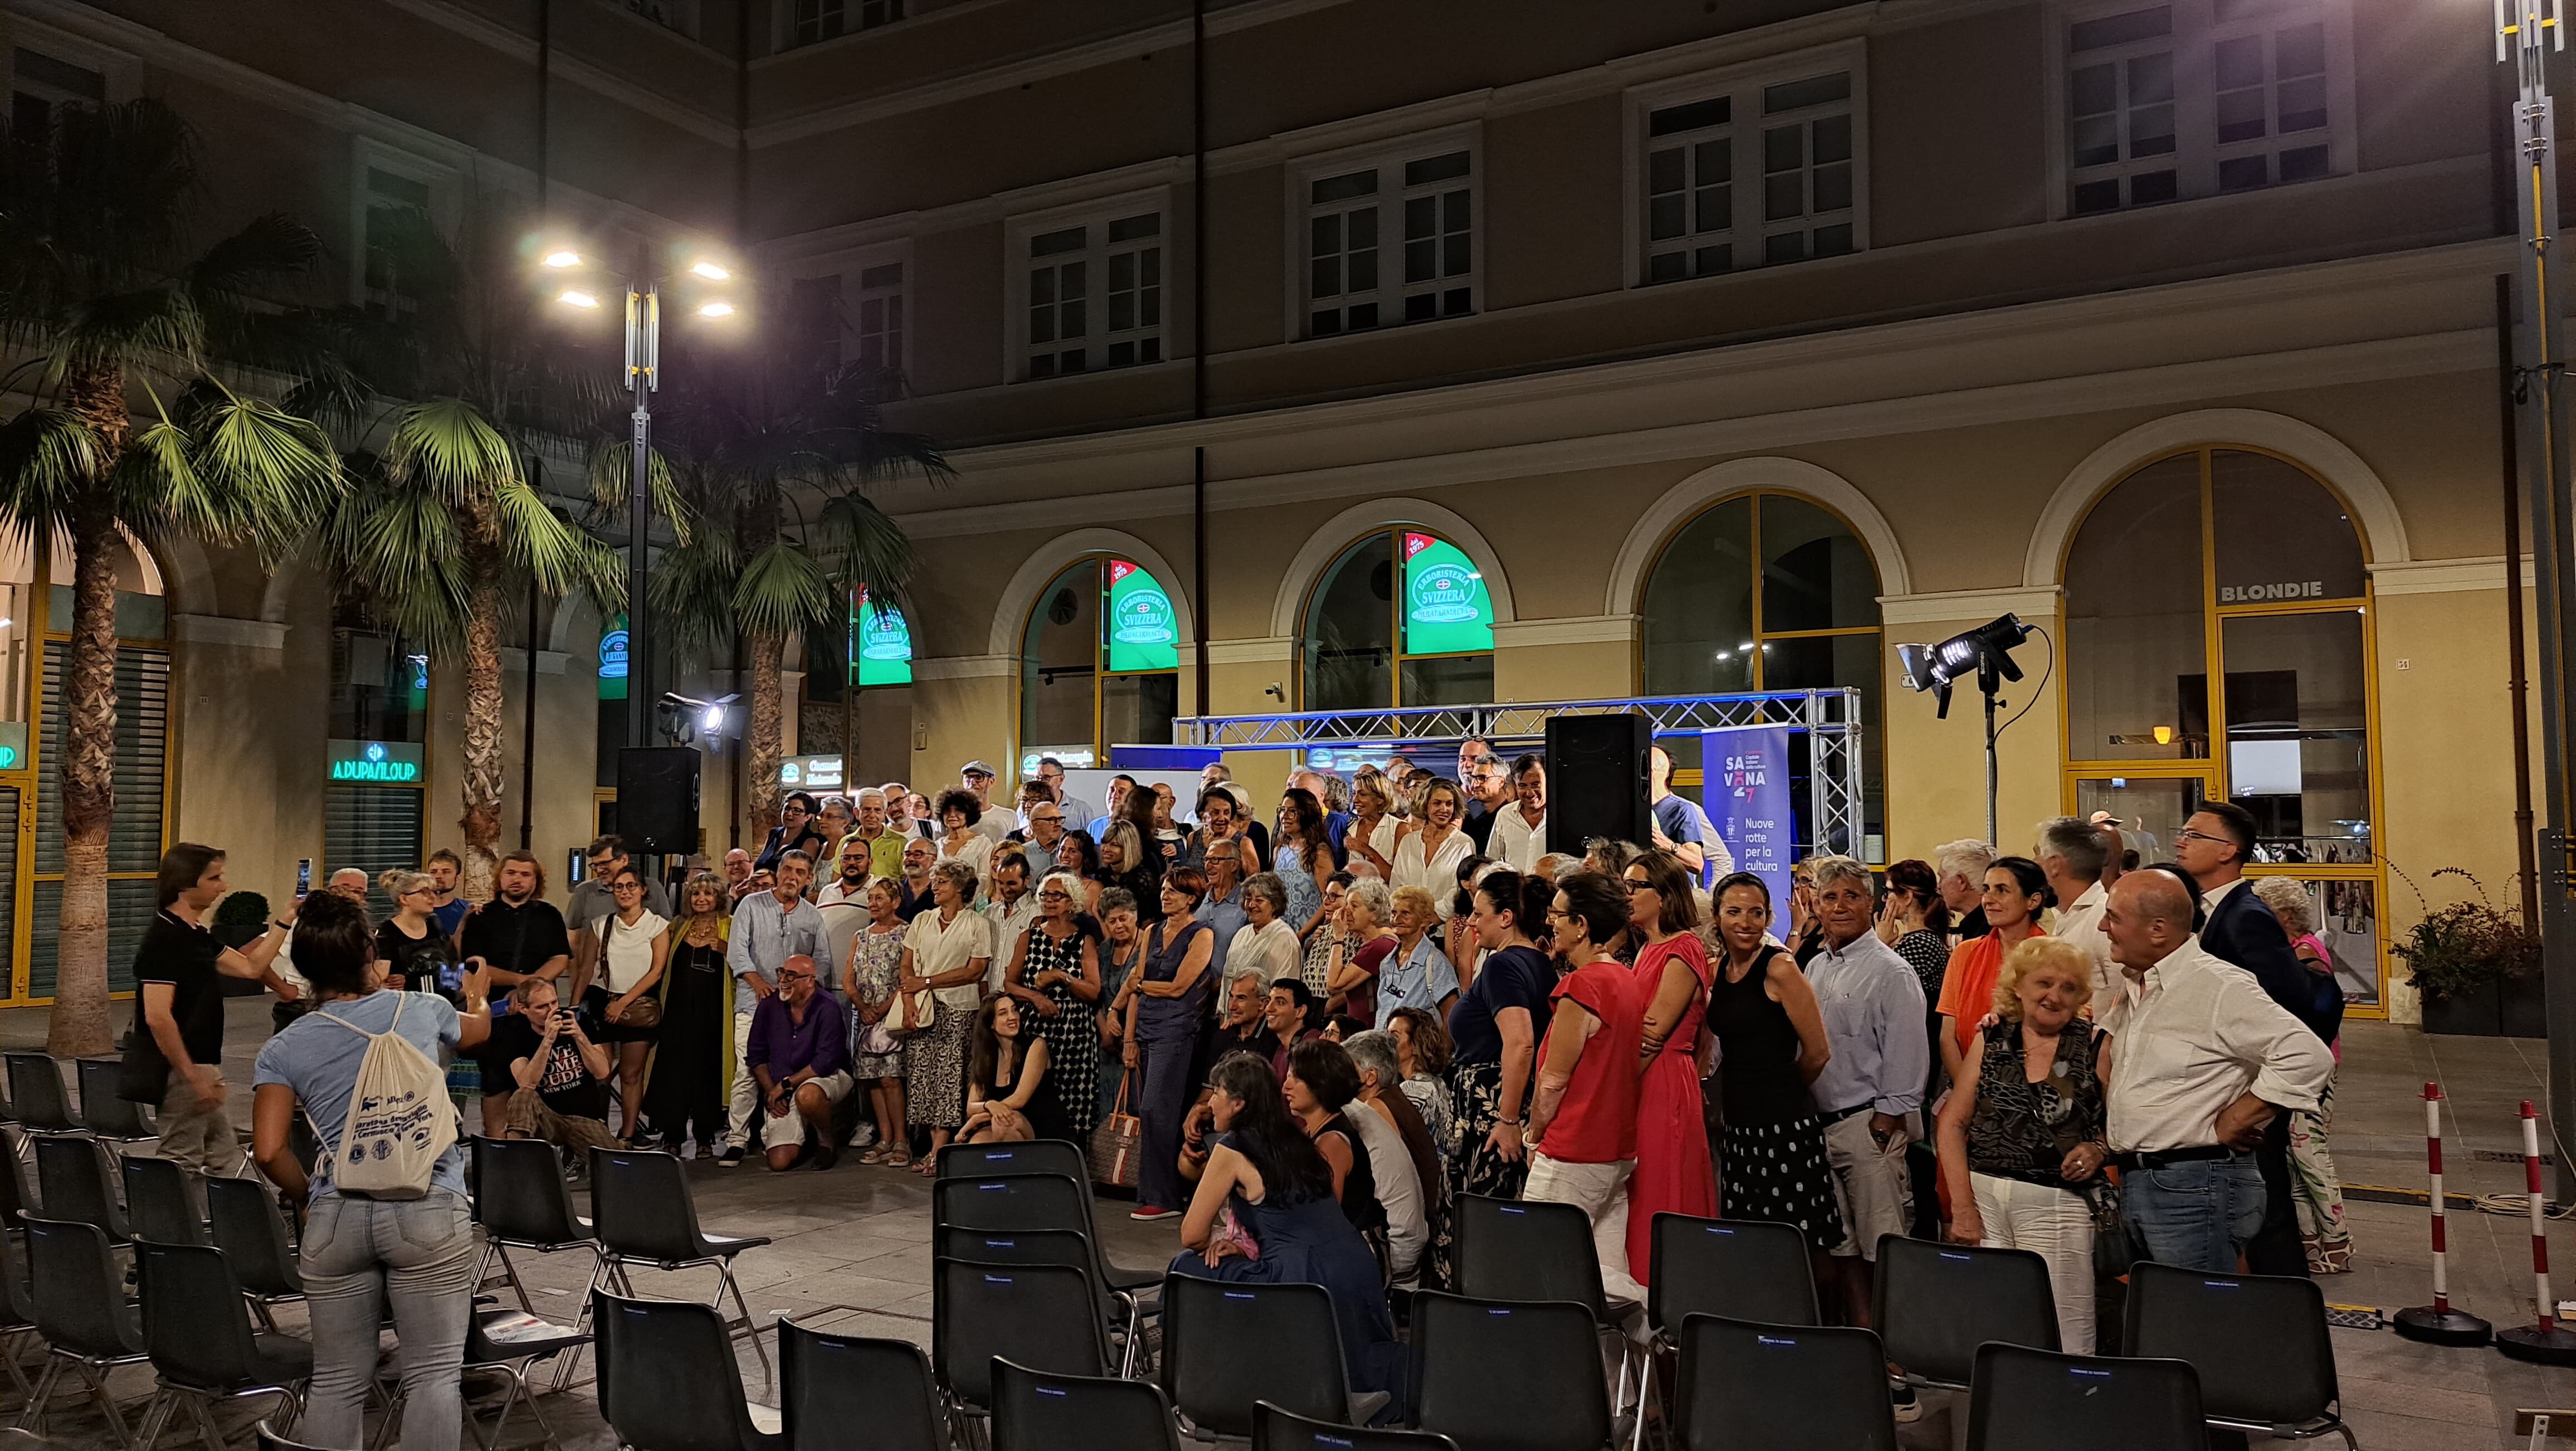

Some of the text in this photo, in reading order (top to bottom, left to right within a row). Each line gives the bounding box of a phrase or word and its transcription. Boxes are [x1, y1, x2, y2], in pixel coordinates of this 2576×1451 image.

[1409, 538, 1418, 546] dal
[1409, 541, 1424, 554] 1975
[1114, 567, 1127, 580] 1975
[1417, 569, 1470, 590] ERBORISTERIA
[1422, 589, 1466, 603] SVIZZERA
[2221, 581, 2322, 602] BLONDIE
[1120, 595, 1165, 613] ERBORISTERIA
[1124, 613, 1161, 625] SVIZZERA
[1726, 756, 1745, 771] SA
[1745, 817, 1774, 829] Nuove
[1745, 832, 1767, 843] rotte
[1745, 845, 1772, 859] per la
[1745, 860, 1778, 871] cultura
[561, 1079, 581, 1091] YORK
